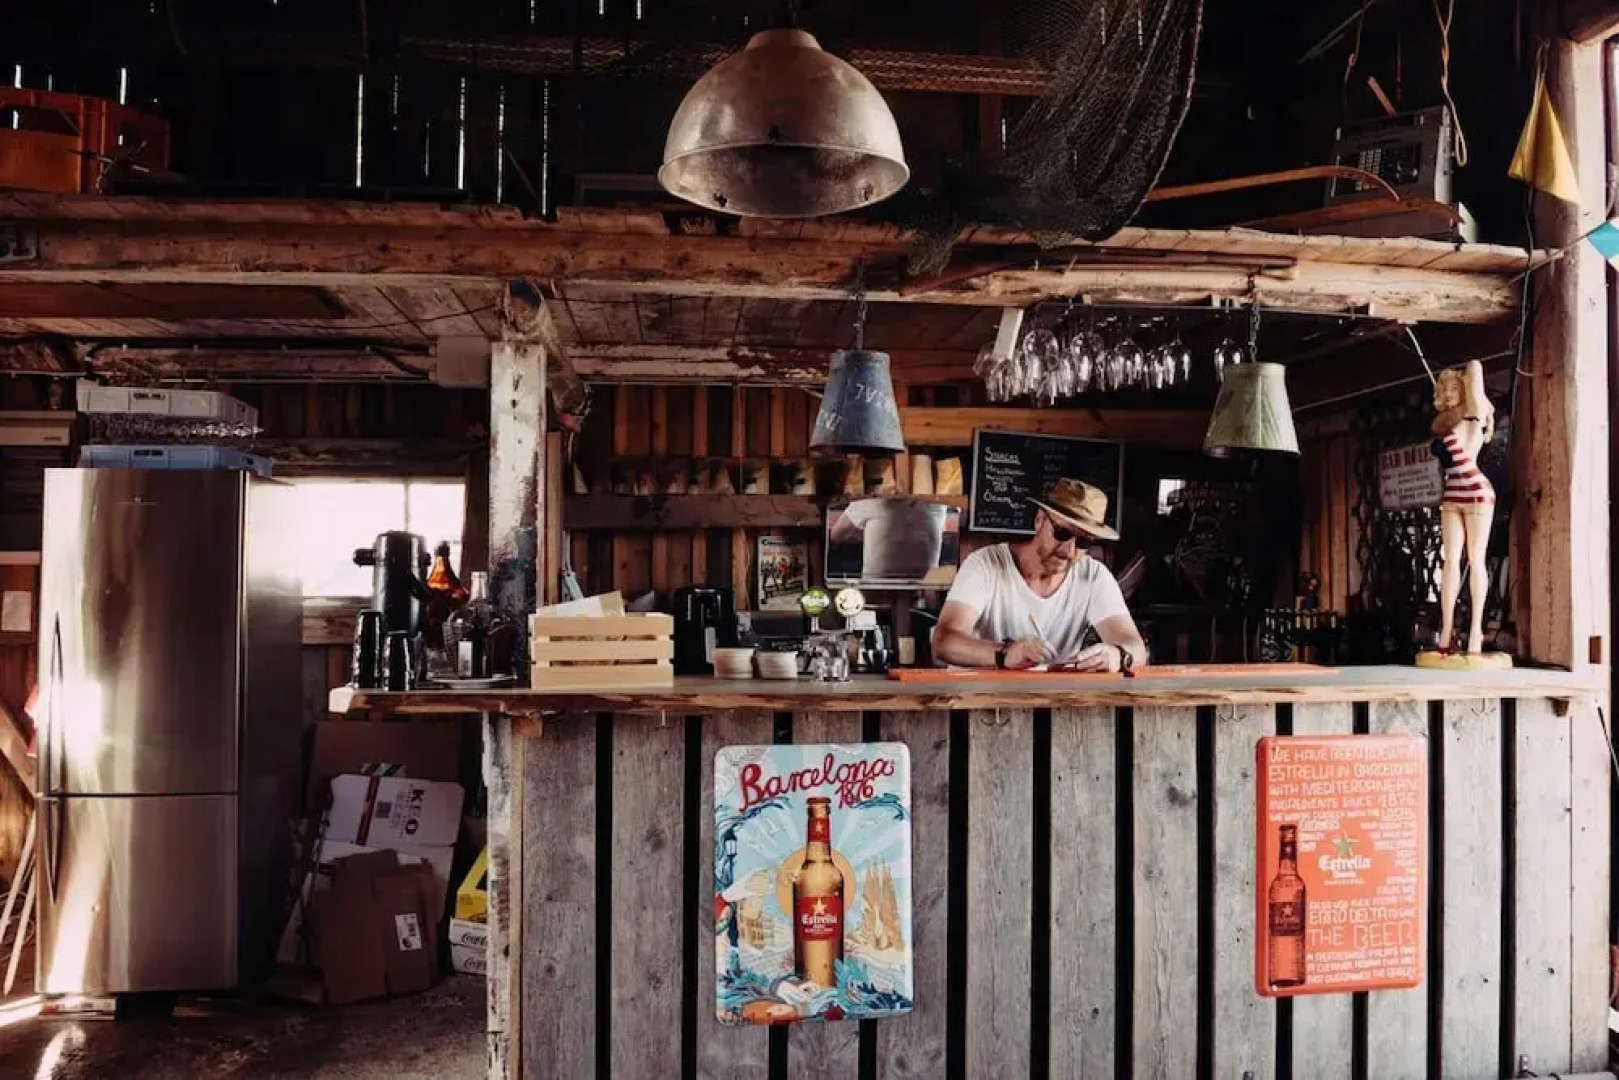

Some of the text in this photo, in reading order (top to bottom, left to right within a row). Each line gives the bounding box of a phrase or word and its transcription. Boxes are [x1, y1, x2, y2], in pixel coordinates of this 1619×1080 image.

[739, 752, 895, 812] Barcelona
[1269, 763, 1334, 782] ESTRELLA
[1318, 854, 1372, 871] Estrella
[1307, 919, 1416, 949] THE BEER
